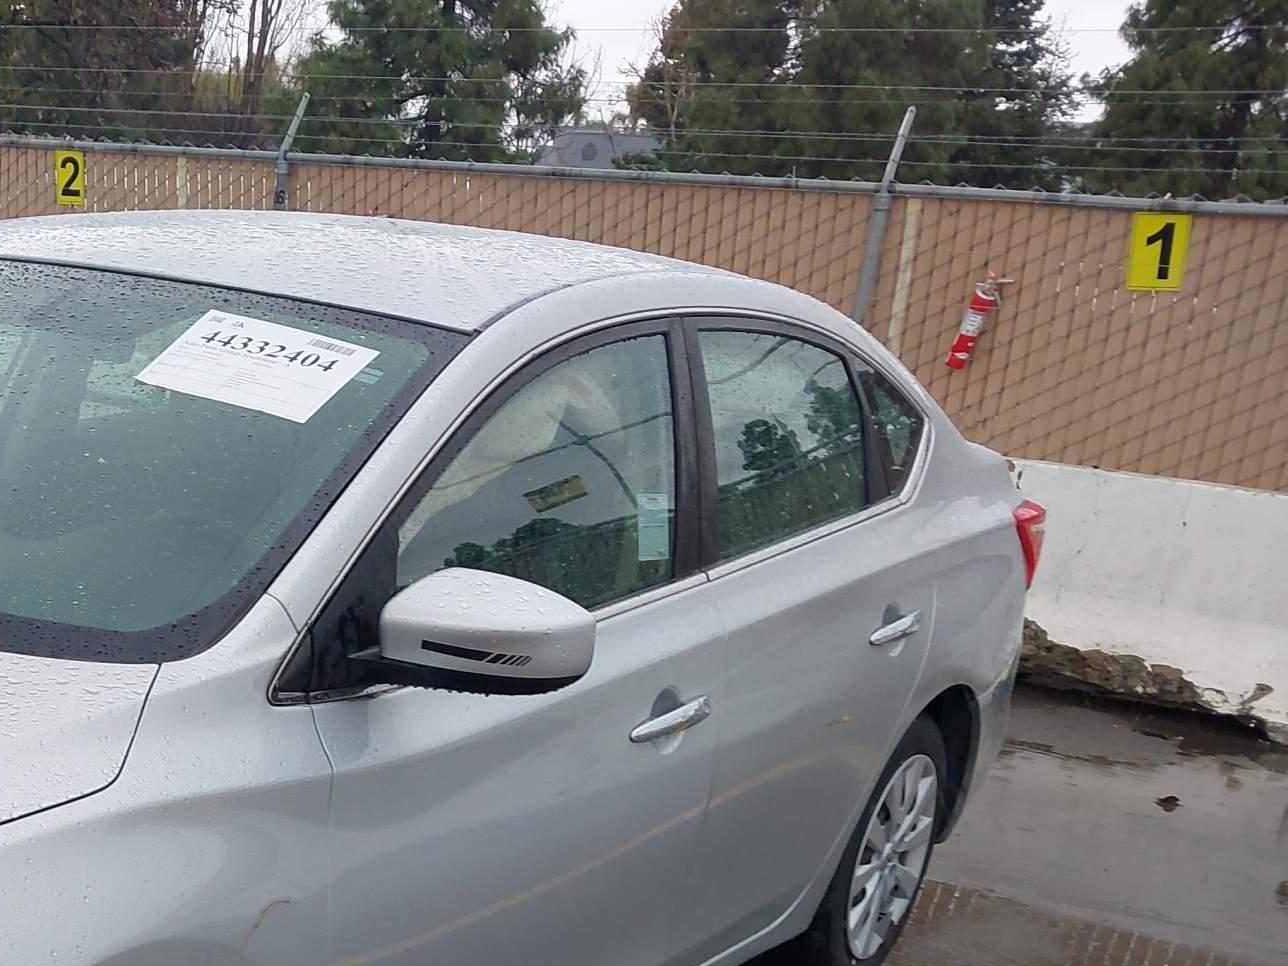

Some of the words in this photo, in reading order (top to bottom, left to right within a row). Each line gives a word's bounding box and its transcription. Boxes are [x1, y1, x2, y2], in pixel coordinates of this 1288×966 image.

[61, 156, 80, 196] 2
[1146, 222, 1176, 279] 1
[200, 330, 339, 371] 44332404
